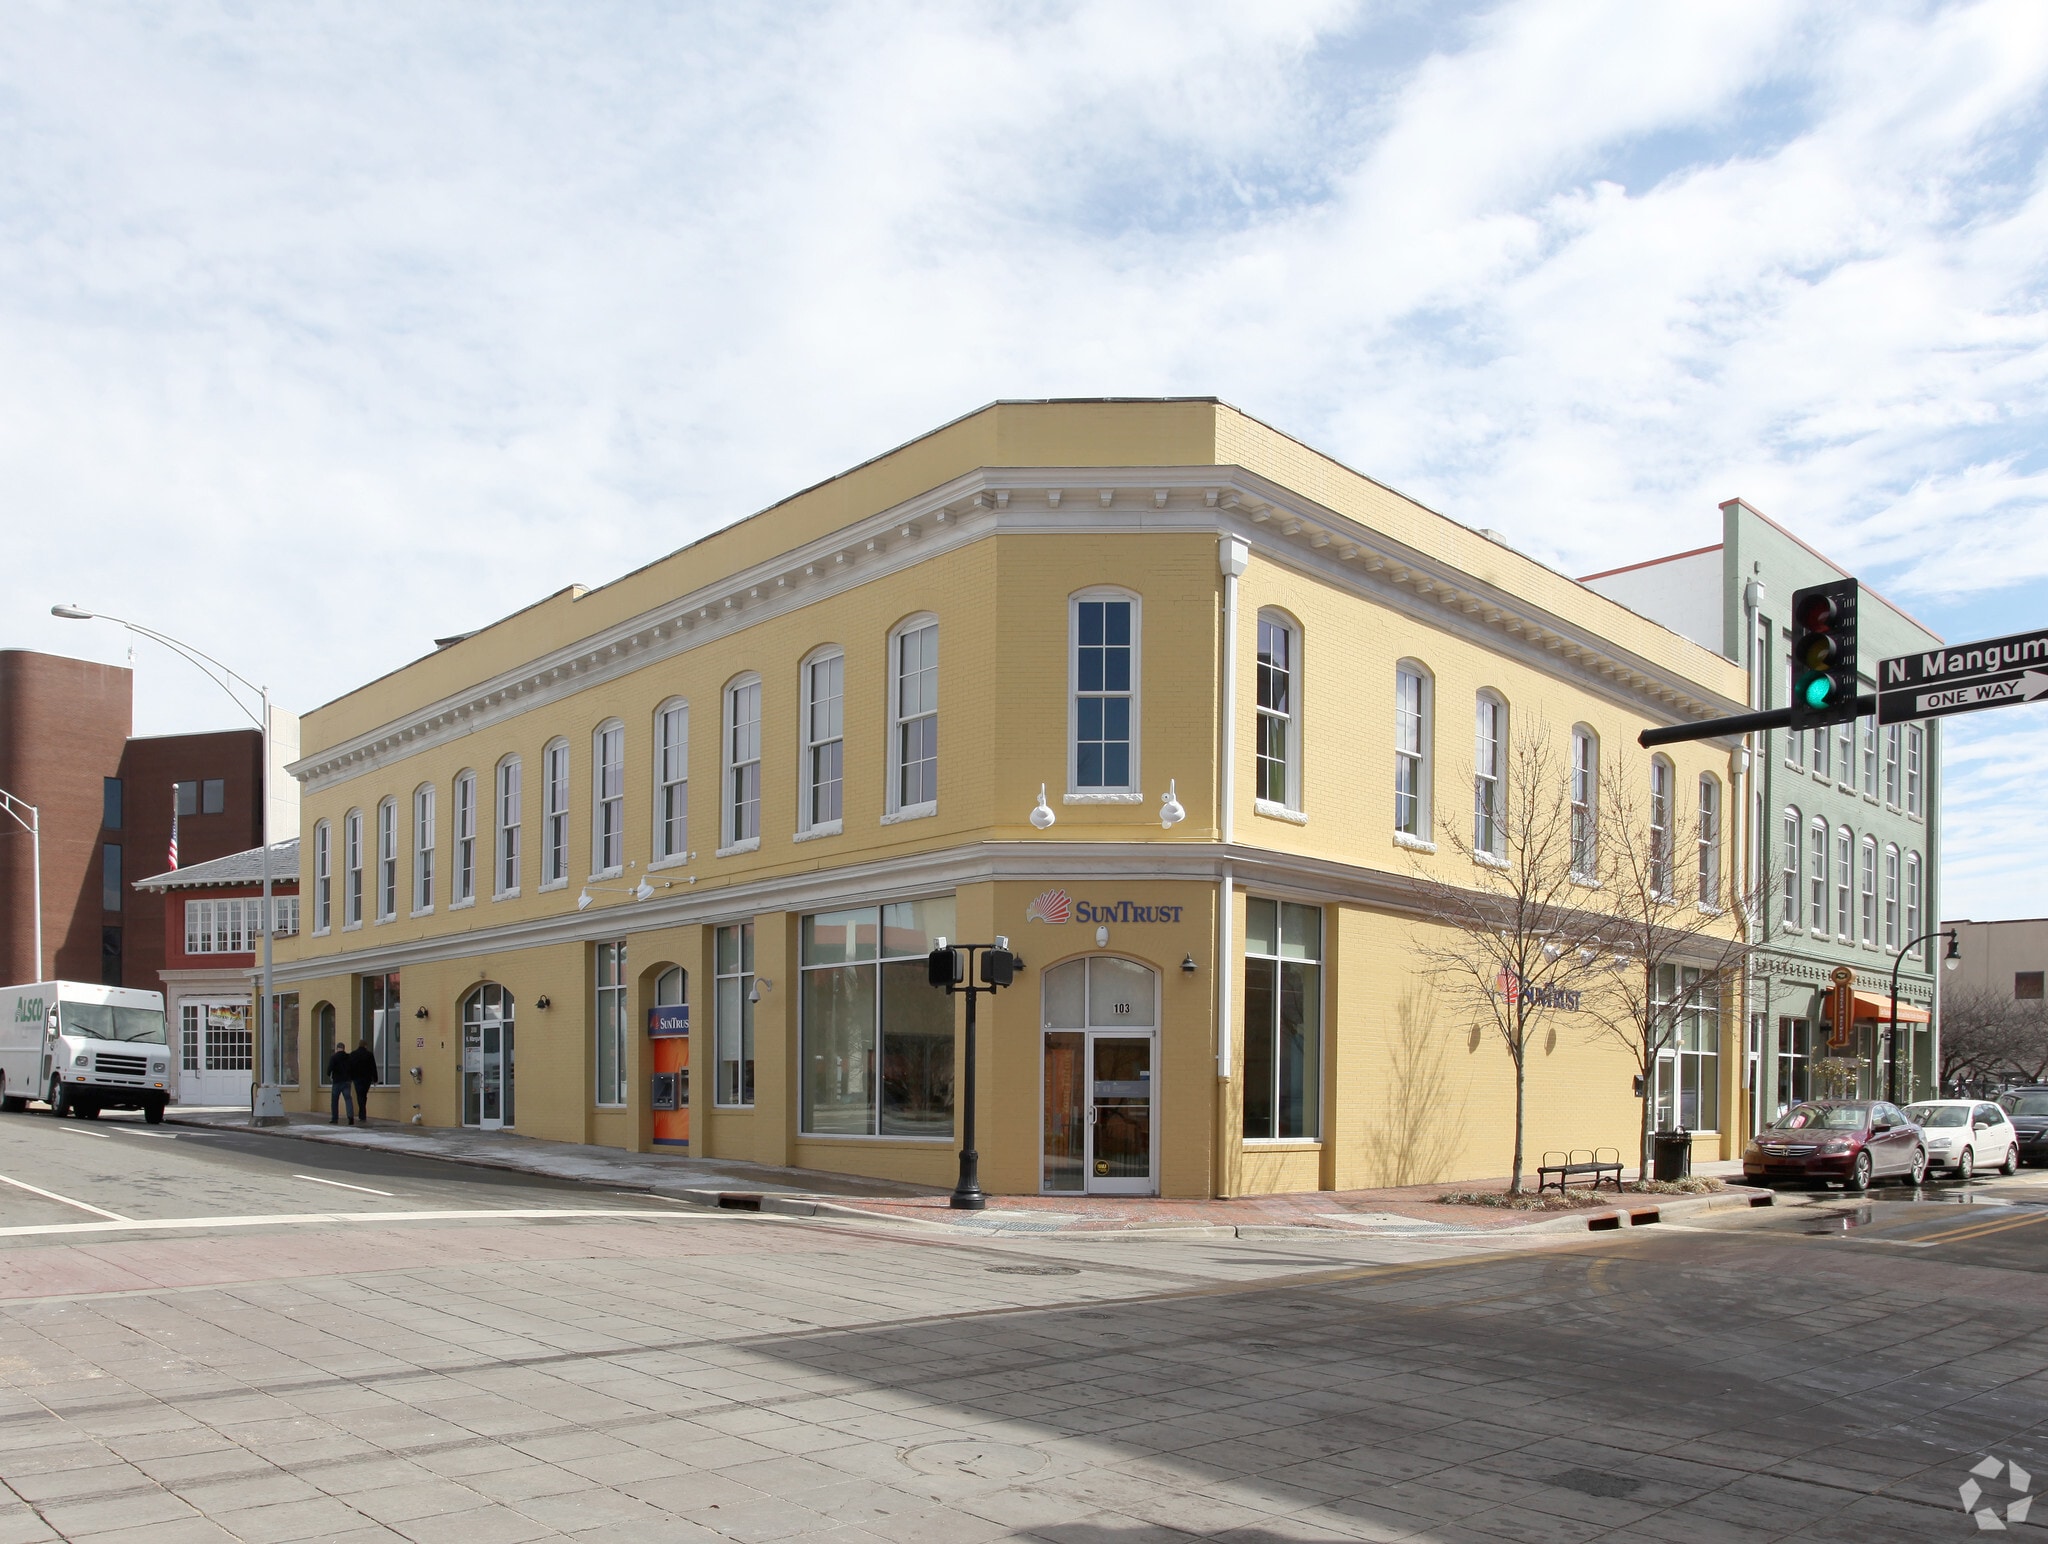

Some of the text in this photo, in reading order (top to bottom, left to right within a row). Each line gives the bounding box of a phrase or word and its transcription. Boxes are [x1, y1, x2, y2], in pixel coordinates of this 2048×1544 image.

[1888, 637, 2048, 683] N. Mangum
[1927, 680, 2019, 708] ONE WAY
[1076, 901, 1183, 923] SUNTRUST
[15, 996, 43, 1023] ALSCO
[1114, 1003, 1130, 1014] 103
[660, 1017, 689, 1030] SUNTRUS
